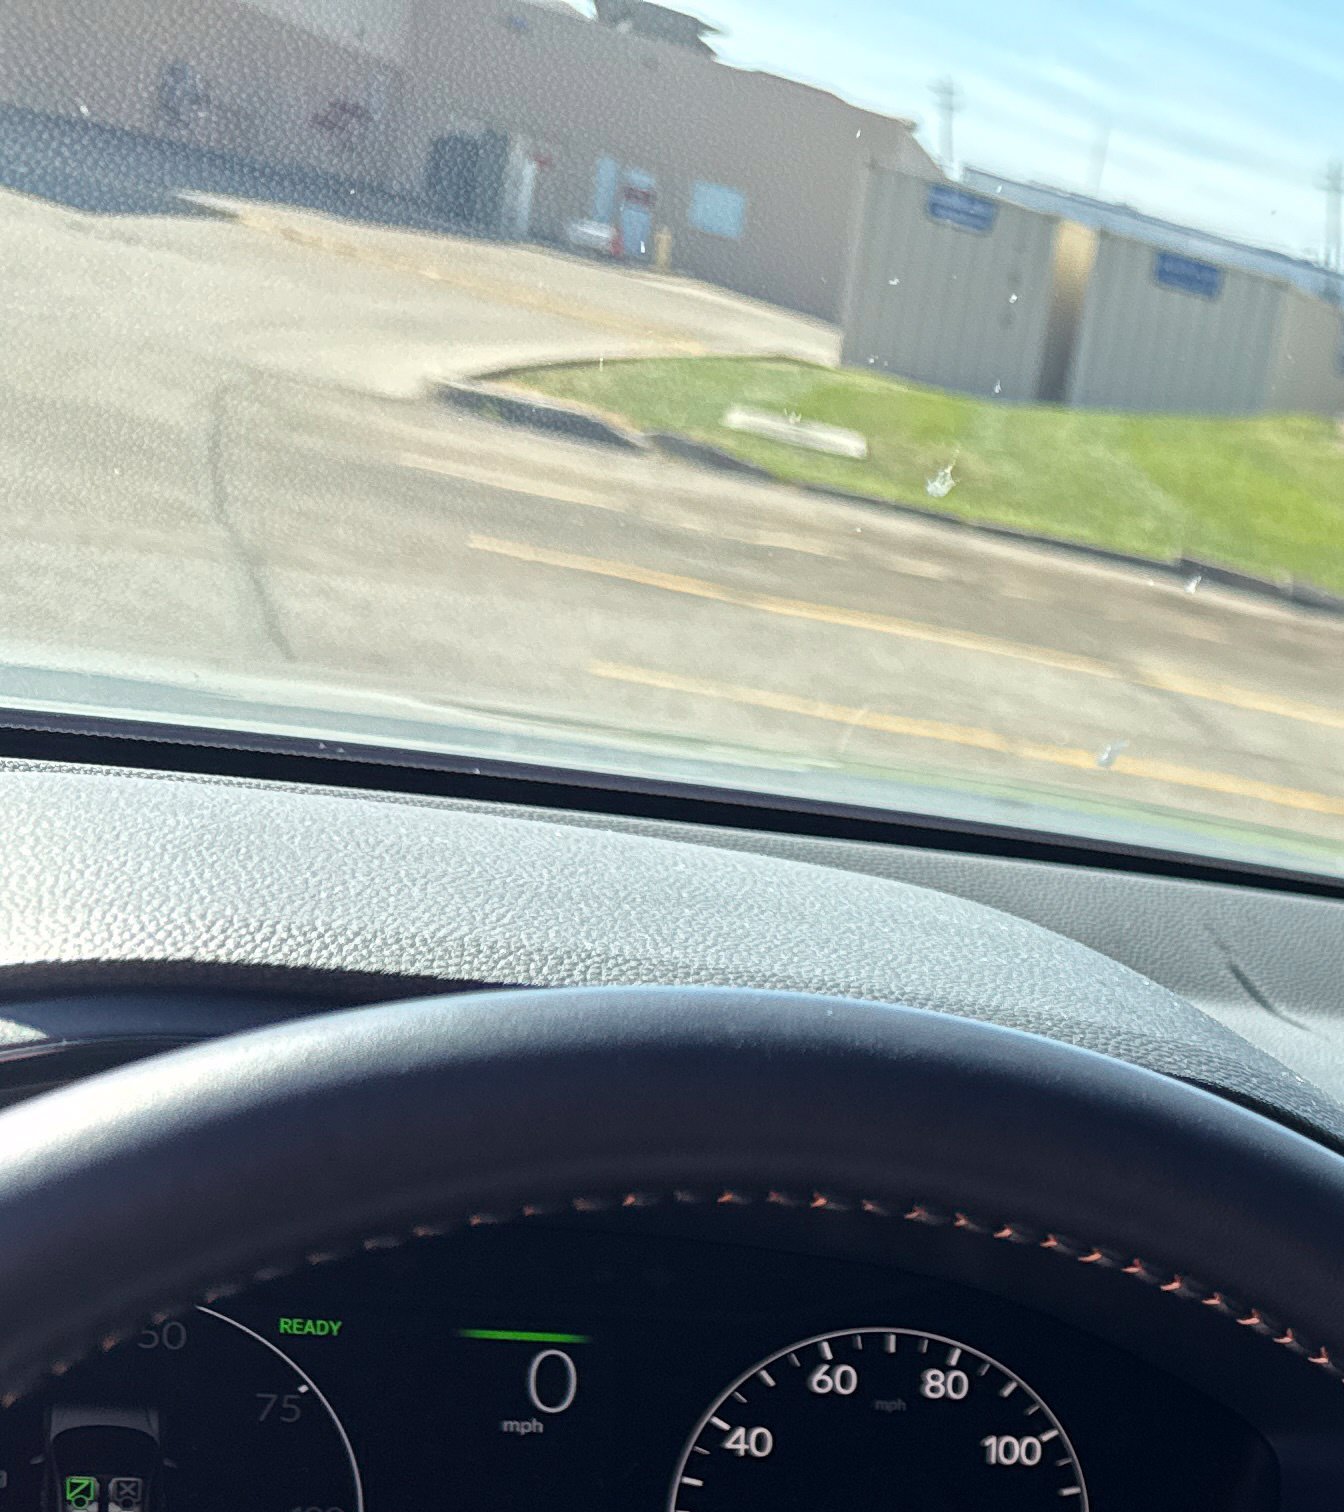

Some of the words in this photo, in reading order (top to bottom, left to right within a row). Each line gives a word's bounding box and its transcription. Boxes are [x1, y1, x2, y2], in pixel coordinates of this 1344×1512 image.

[279, 1317, 342, 1337] READY
[528, 1349, 578, 1414] 0
[807, 1363, 858, 1395] 60
[920, 1368, 970, 1400] 80
[256, 1392, 302, 1423] 75
[874, 1397, 907, 1414] mph
[502, 1416, 545, 1437] mph
[724, 1426, 774, 1457] 40
[981, 1435, 1043, 1467] 100
